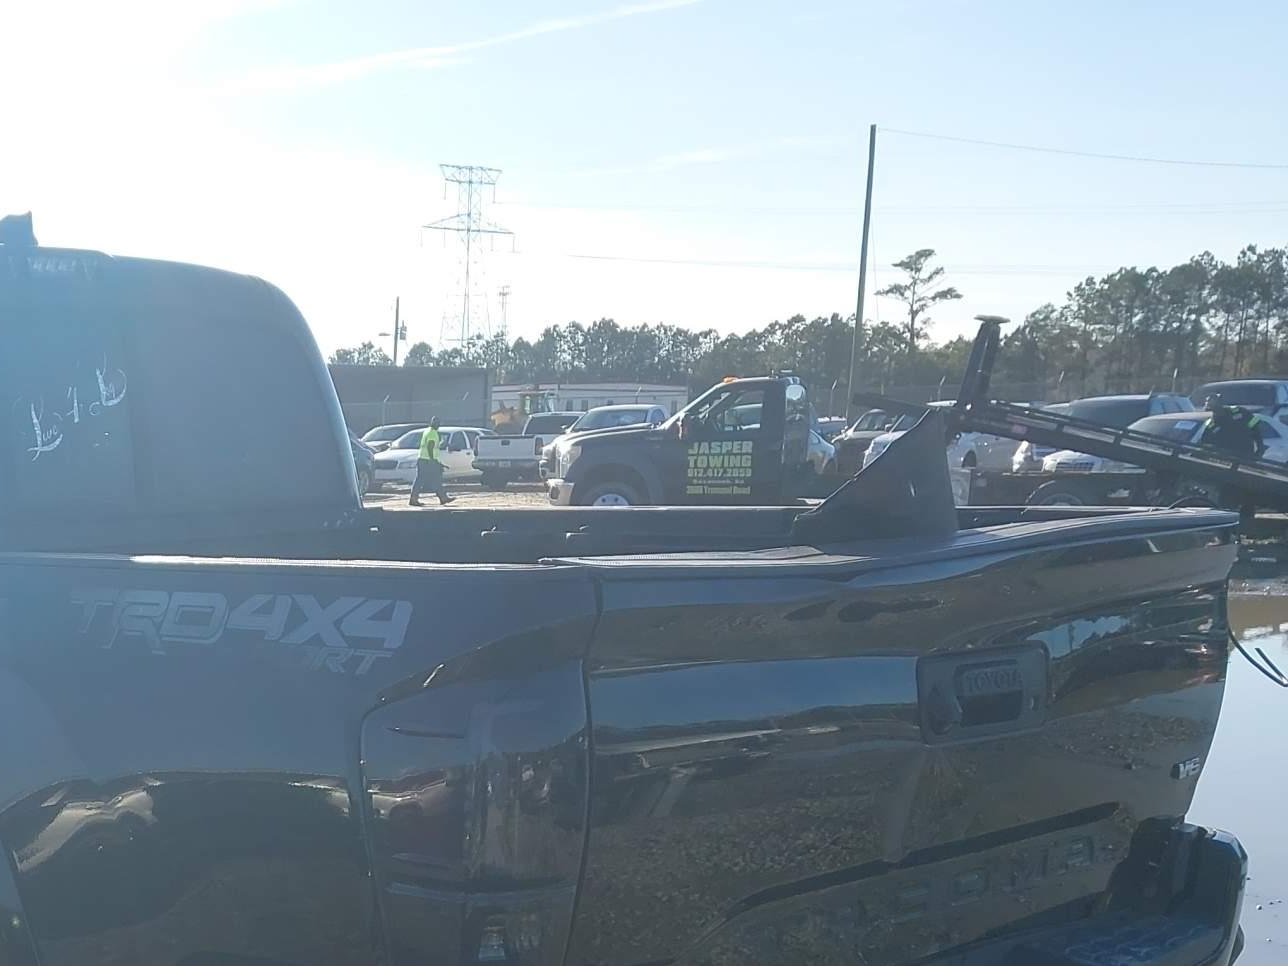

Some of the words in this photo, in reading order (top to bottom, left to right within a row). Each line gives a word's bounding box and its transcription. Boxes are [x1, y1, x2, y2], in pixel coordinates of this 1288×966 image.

[687, 440, 753, 454] JASPER
[687, 455, 752, 468] TOWING
[965, 669, 1024, 692] TOYOTA
[1178, 757, 1201, 780] V6
